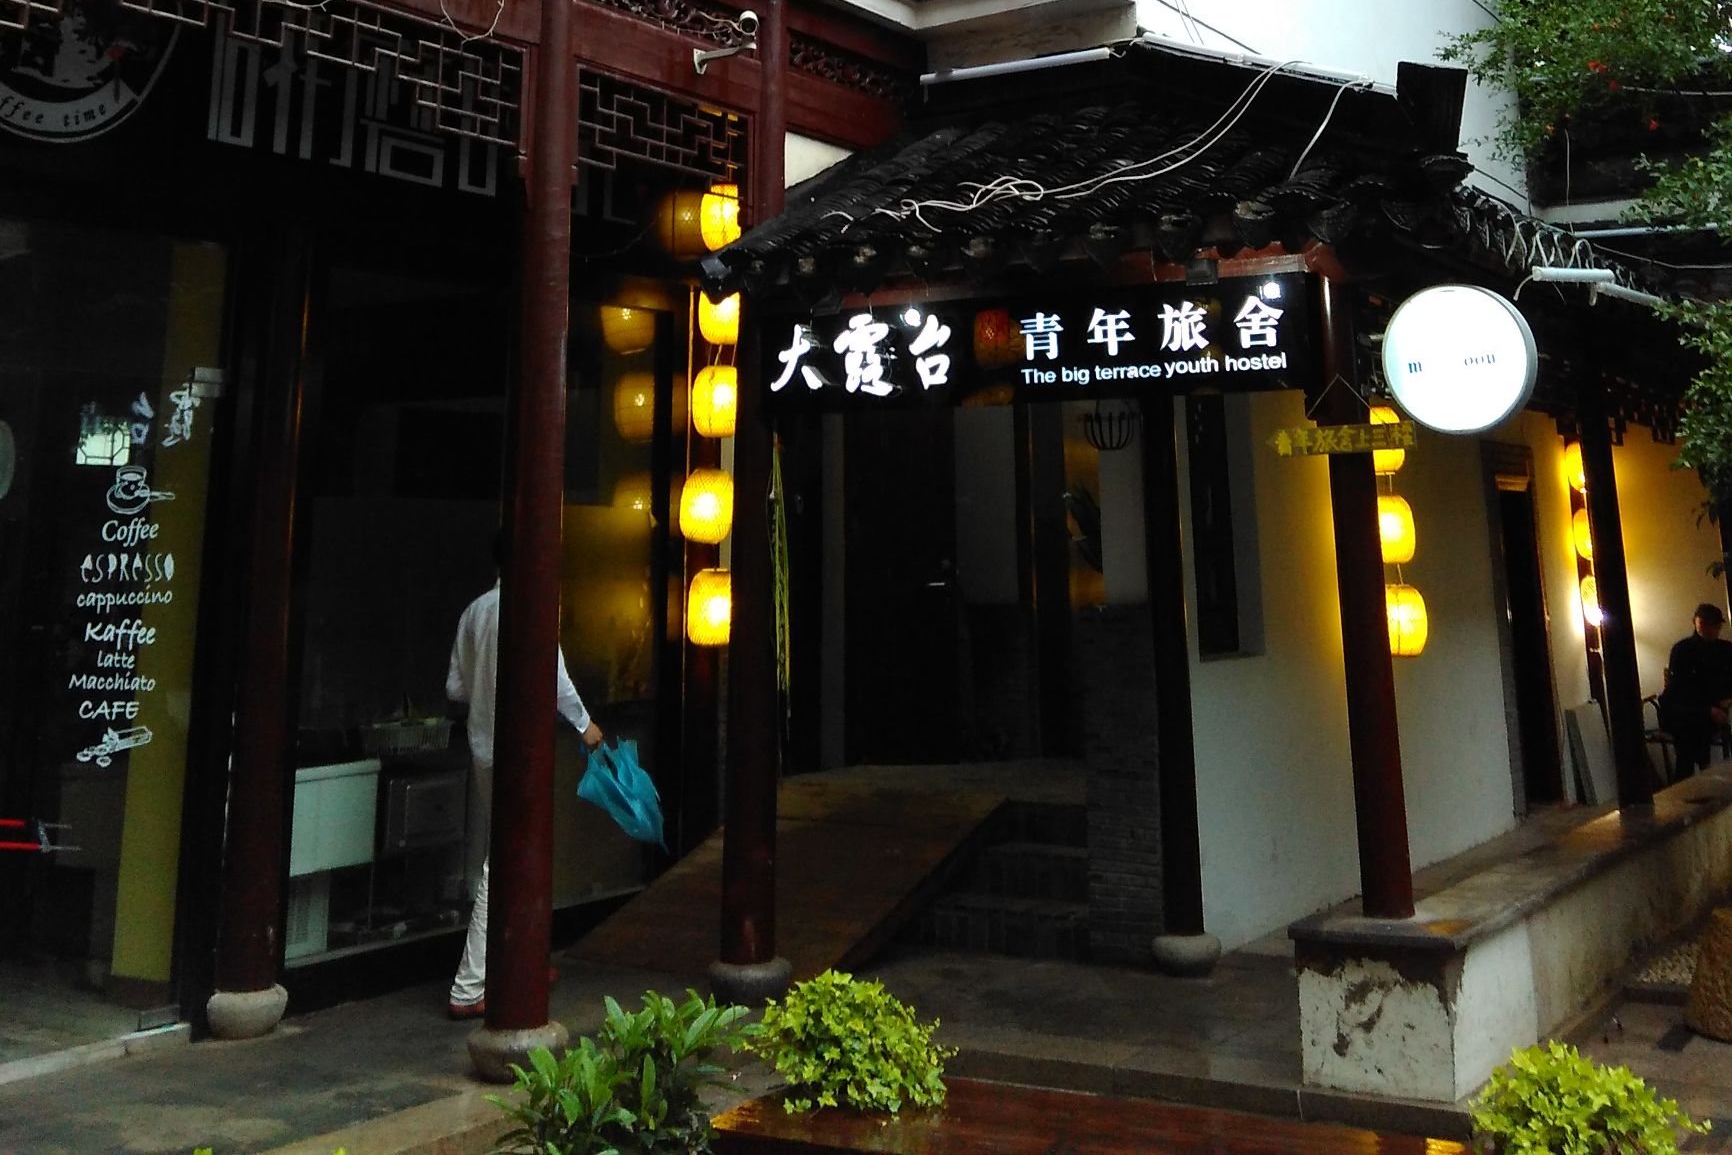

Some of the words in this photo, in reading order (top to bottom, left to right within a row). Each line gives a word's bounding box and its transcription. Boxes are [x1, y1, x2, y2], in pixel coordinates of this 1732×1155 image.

[63, 103, 106, 127] time
[1019, 295, 1285, 361] 青年旅舍
[1021, 367, 1056, 385] The
[1061, 366, 1090, 385] big
[1095, 363, 1162, 381] terrace
[1165, 351, 1219, 379] youth
[1225, 352, 1288, 372] hostel
[101, 516, 160, 548] Coffee
[76, 584, 173, 615] cappuccino
[84, 617, 156, 651] Kaffee
[68, 668, 156, 693] Macchiato
[79, 698, 140, 721] CAFE
